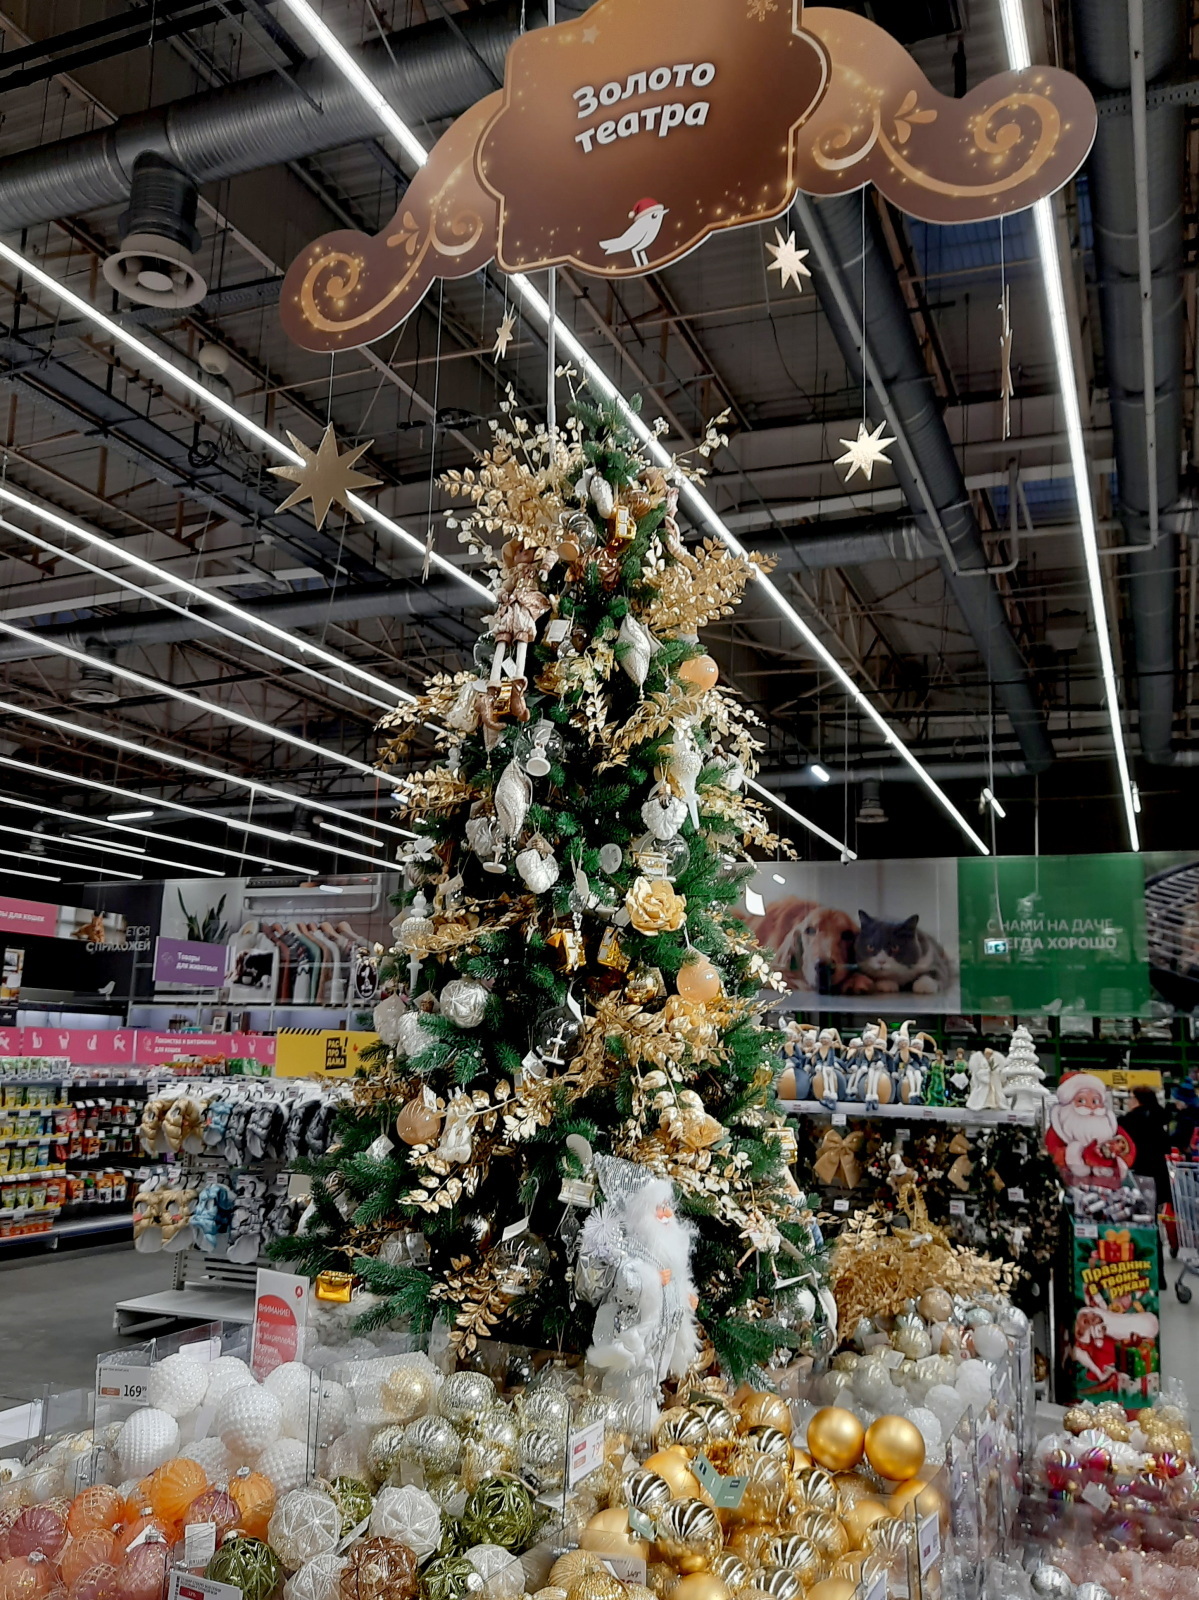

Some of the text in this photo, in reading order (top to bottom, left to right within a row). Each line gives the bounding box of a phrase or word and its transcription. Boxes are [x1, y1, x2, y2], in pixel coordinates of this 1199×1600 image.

[572, 62, 716, 119] Золото
[574, 101, 710, 154] театра
[1002, 919, 1044, 931] НАМИ
[1047, 919, 1069, 931] НА
[1071, 918, 1114, 934] ДАЧЕ
[1047, 937, 1118, 950] ХОРОШО
[1081, 1261, 1151, 1284] Праздник
[1088, 1271, 1139, 1296] в твоих
[258, 1303, 291, 1317] ВНИМАНИЕ!
[123, 1384, 142, 1398] 169
